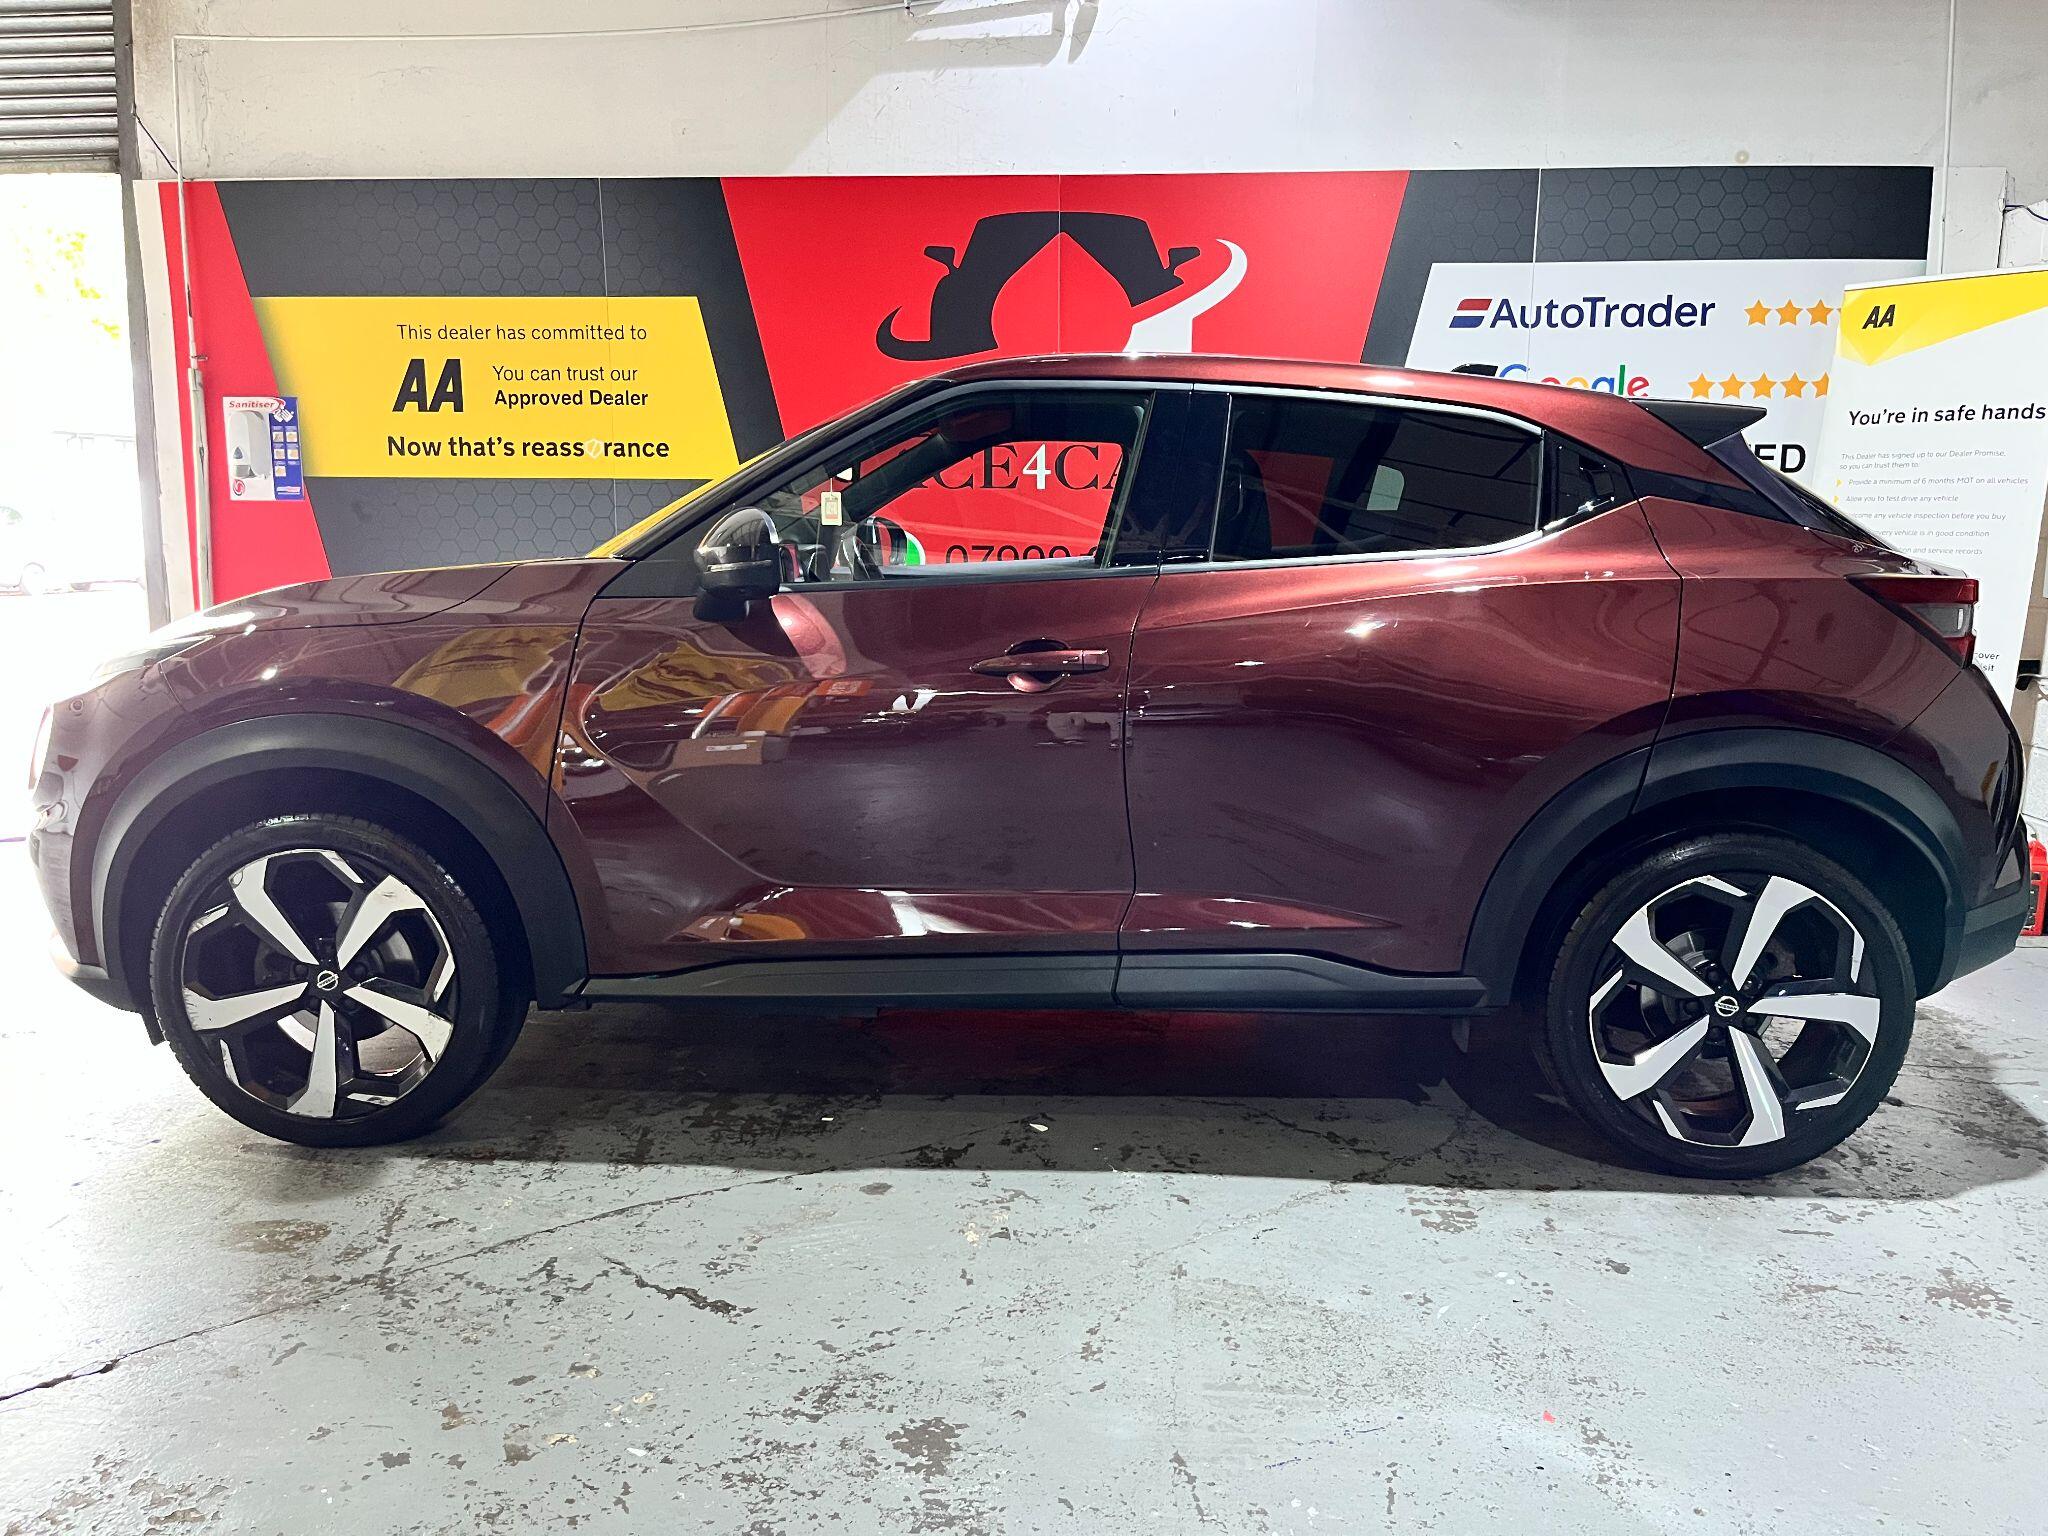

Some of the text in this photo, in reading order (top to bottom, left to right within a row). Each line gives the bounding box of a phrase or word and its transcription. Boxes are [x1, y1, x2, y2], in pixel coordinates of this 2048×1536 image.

[1490, 294, 1715, 329] AutoTrader
[1861, 304, 1896, 329] AA
[397, 324, 647, 340] This dealer has committed to
[492, 366, 638, 381] You can trust our
[392, 358, 464, 412] AA
[494, 390, 648, 409] Approved Dealer
[1849, 403, 2047, 426] You're in safe hands
[388, 436, 441, 457] Now
[448, 436, 515, 457] that's
[1891, 452, 1915, 460] signed
[1848, 464, 1861, 472] you
[1913, 512, 1950, 520] inspection
[1951, 512, 1975, 520] before
[1991, 513, 2007, 521] buy
[1935, 530, 1954, 538] good
[1974, 652, 2000, 660] over
